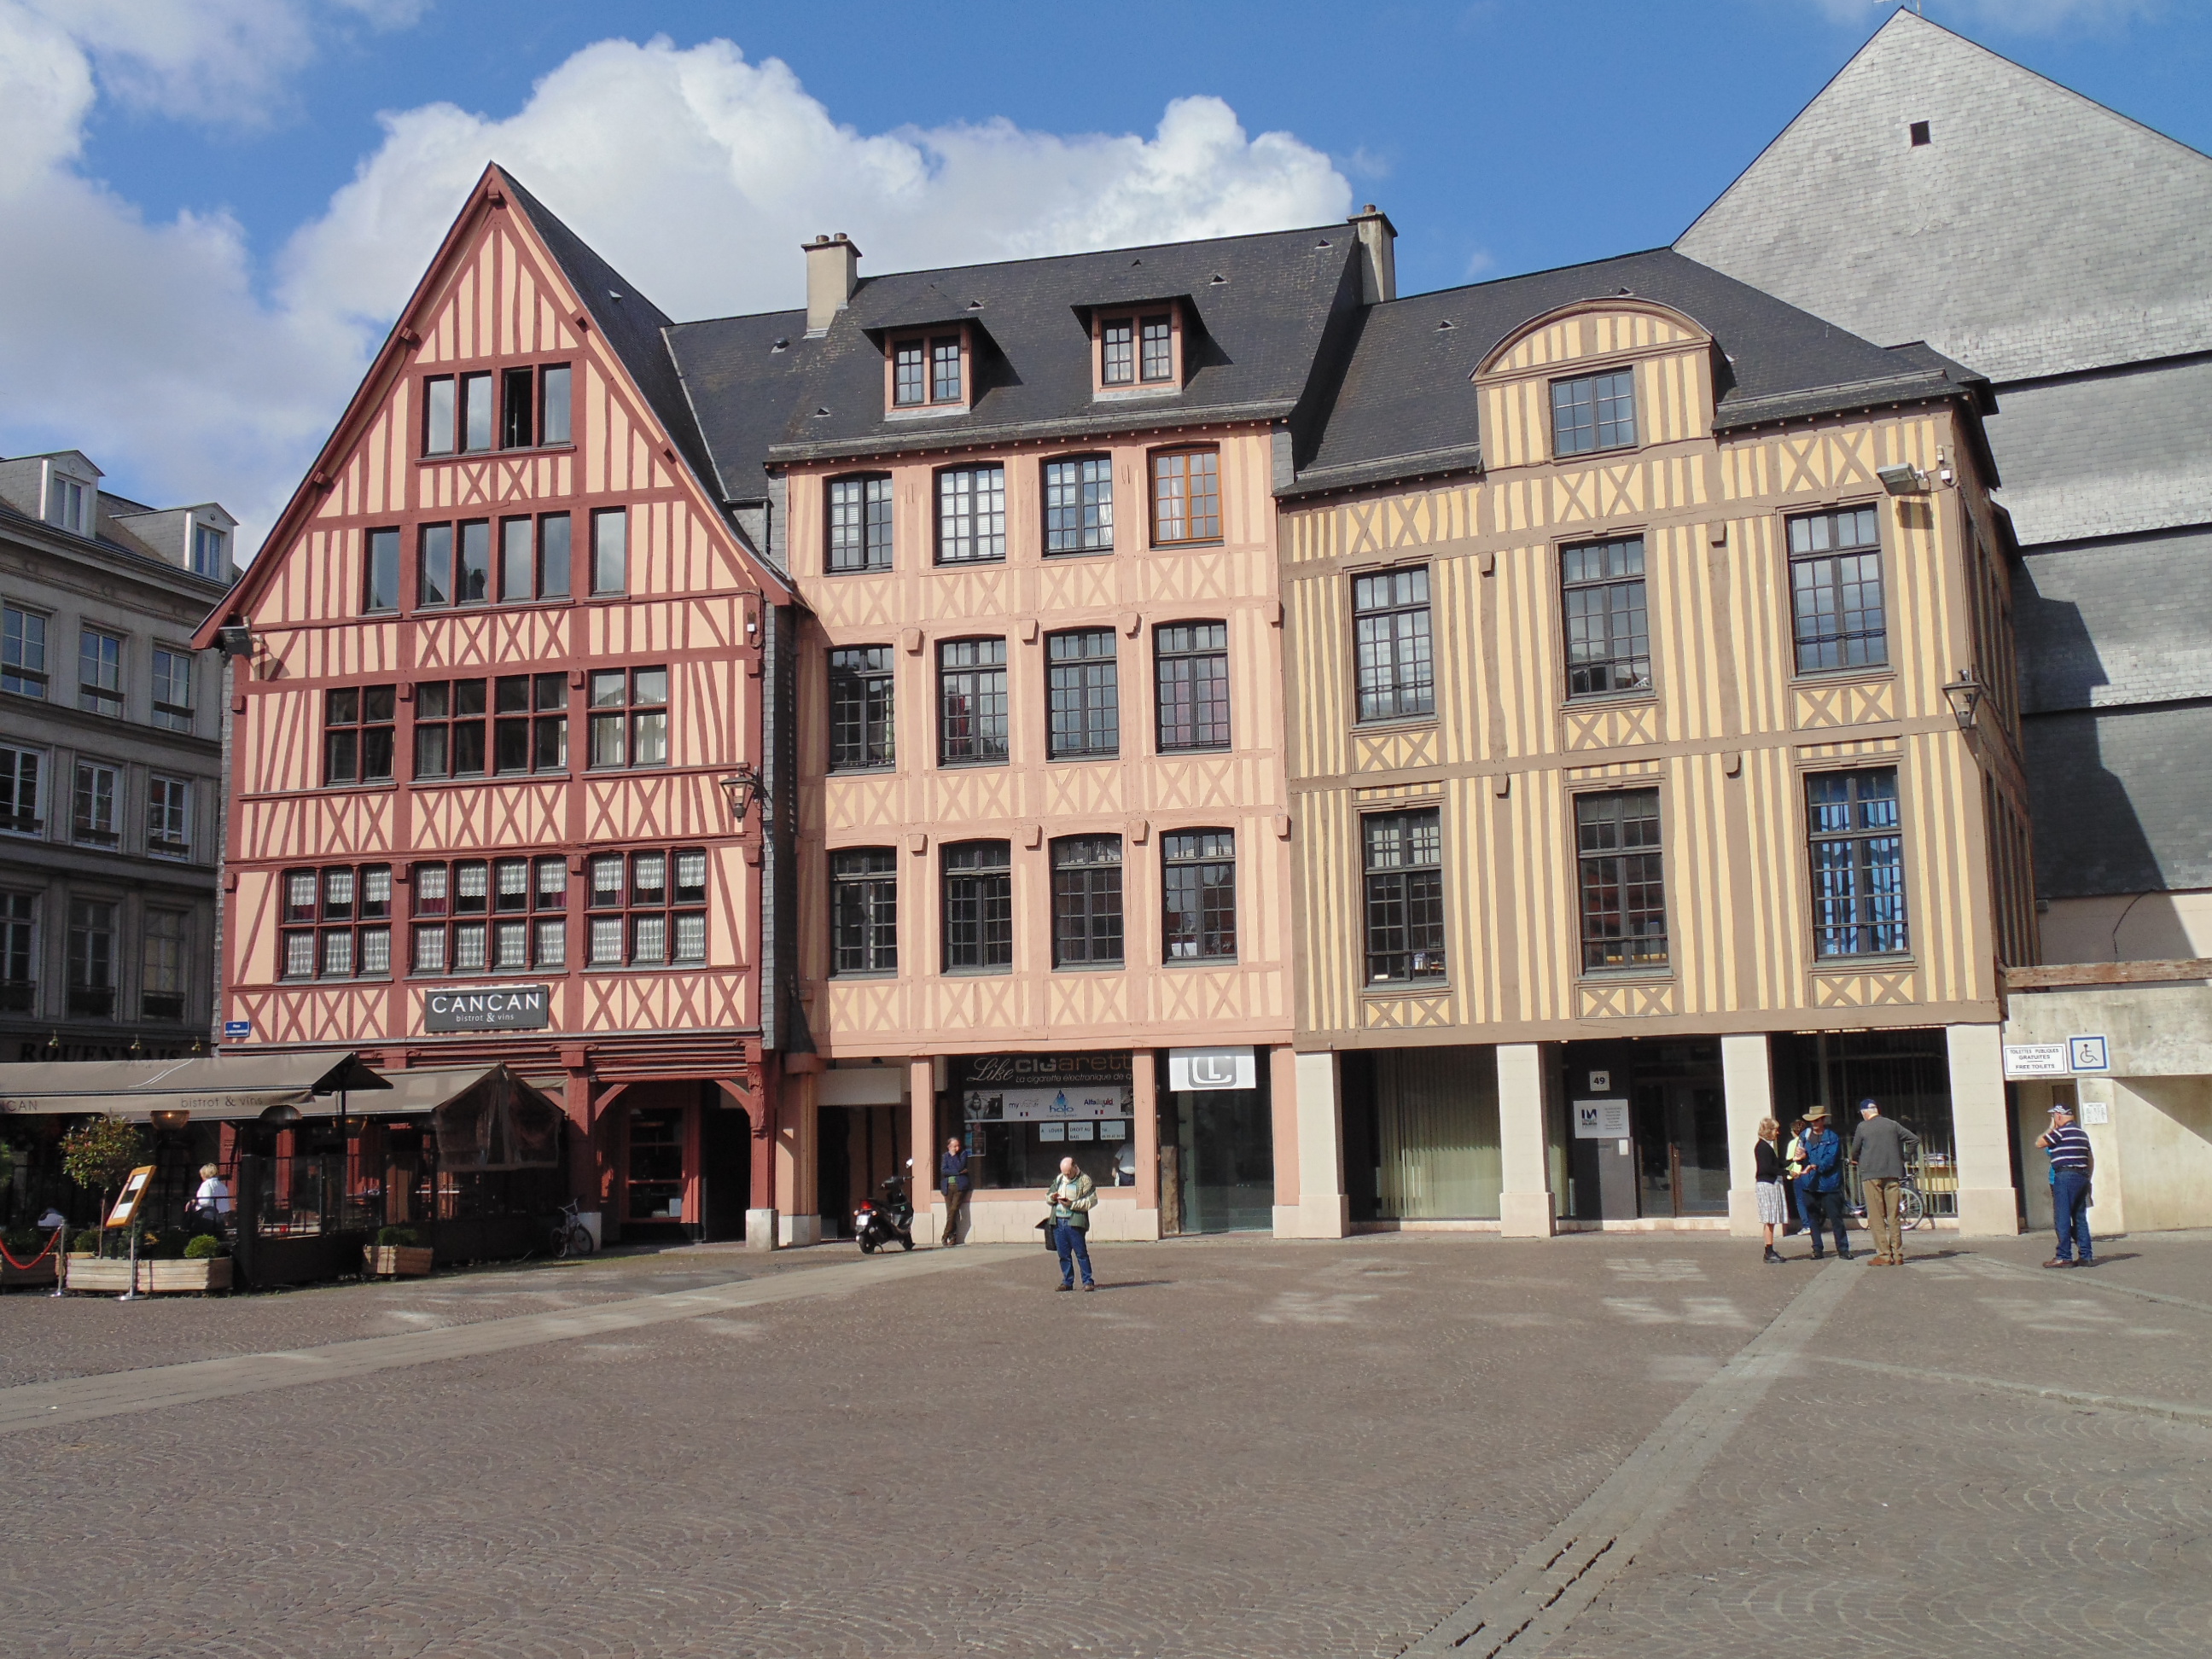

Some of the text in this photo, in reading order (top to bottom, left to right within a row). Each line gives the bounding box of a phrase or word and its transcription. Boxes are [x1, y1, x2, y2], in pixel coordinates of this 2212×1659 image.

[432, 992, 539, 1014] CANCAN
[456, 1014, 483, 1022] bistrot
[486, 1013, 495, 1022] &
[19, 1043, 182, 1062] ROUENNAIS
[966, 1057, 1014, 1081] Like
[1027, 1074, 1062, 1084] cigarette
[1063, 1073, 1111, 1082] électronique
[1126, 1074, 1133, 1082] q
[181, 1096, 263, 1108] bistrot & vins
